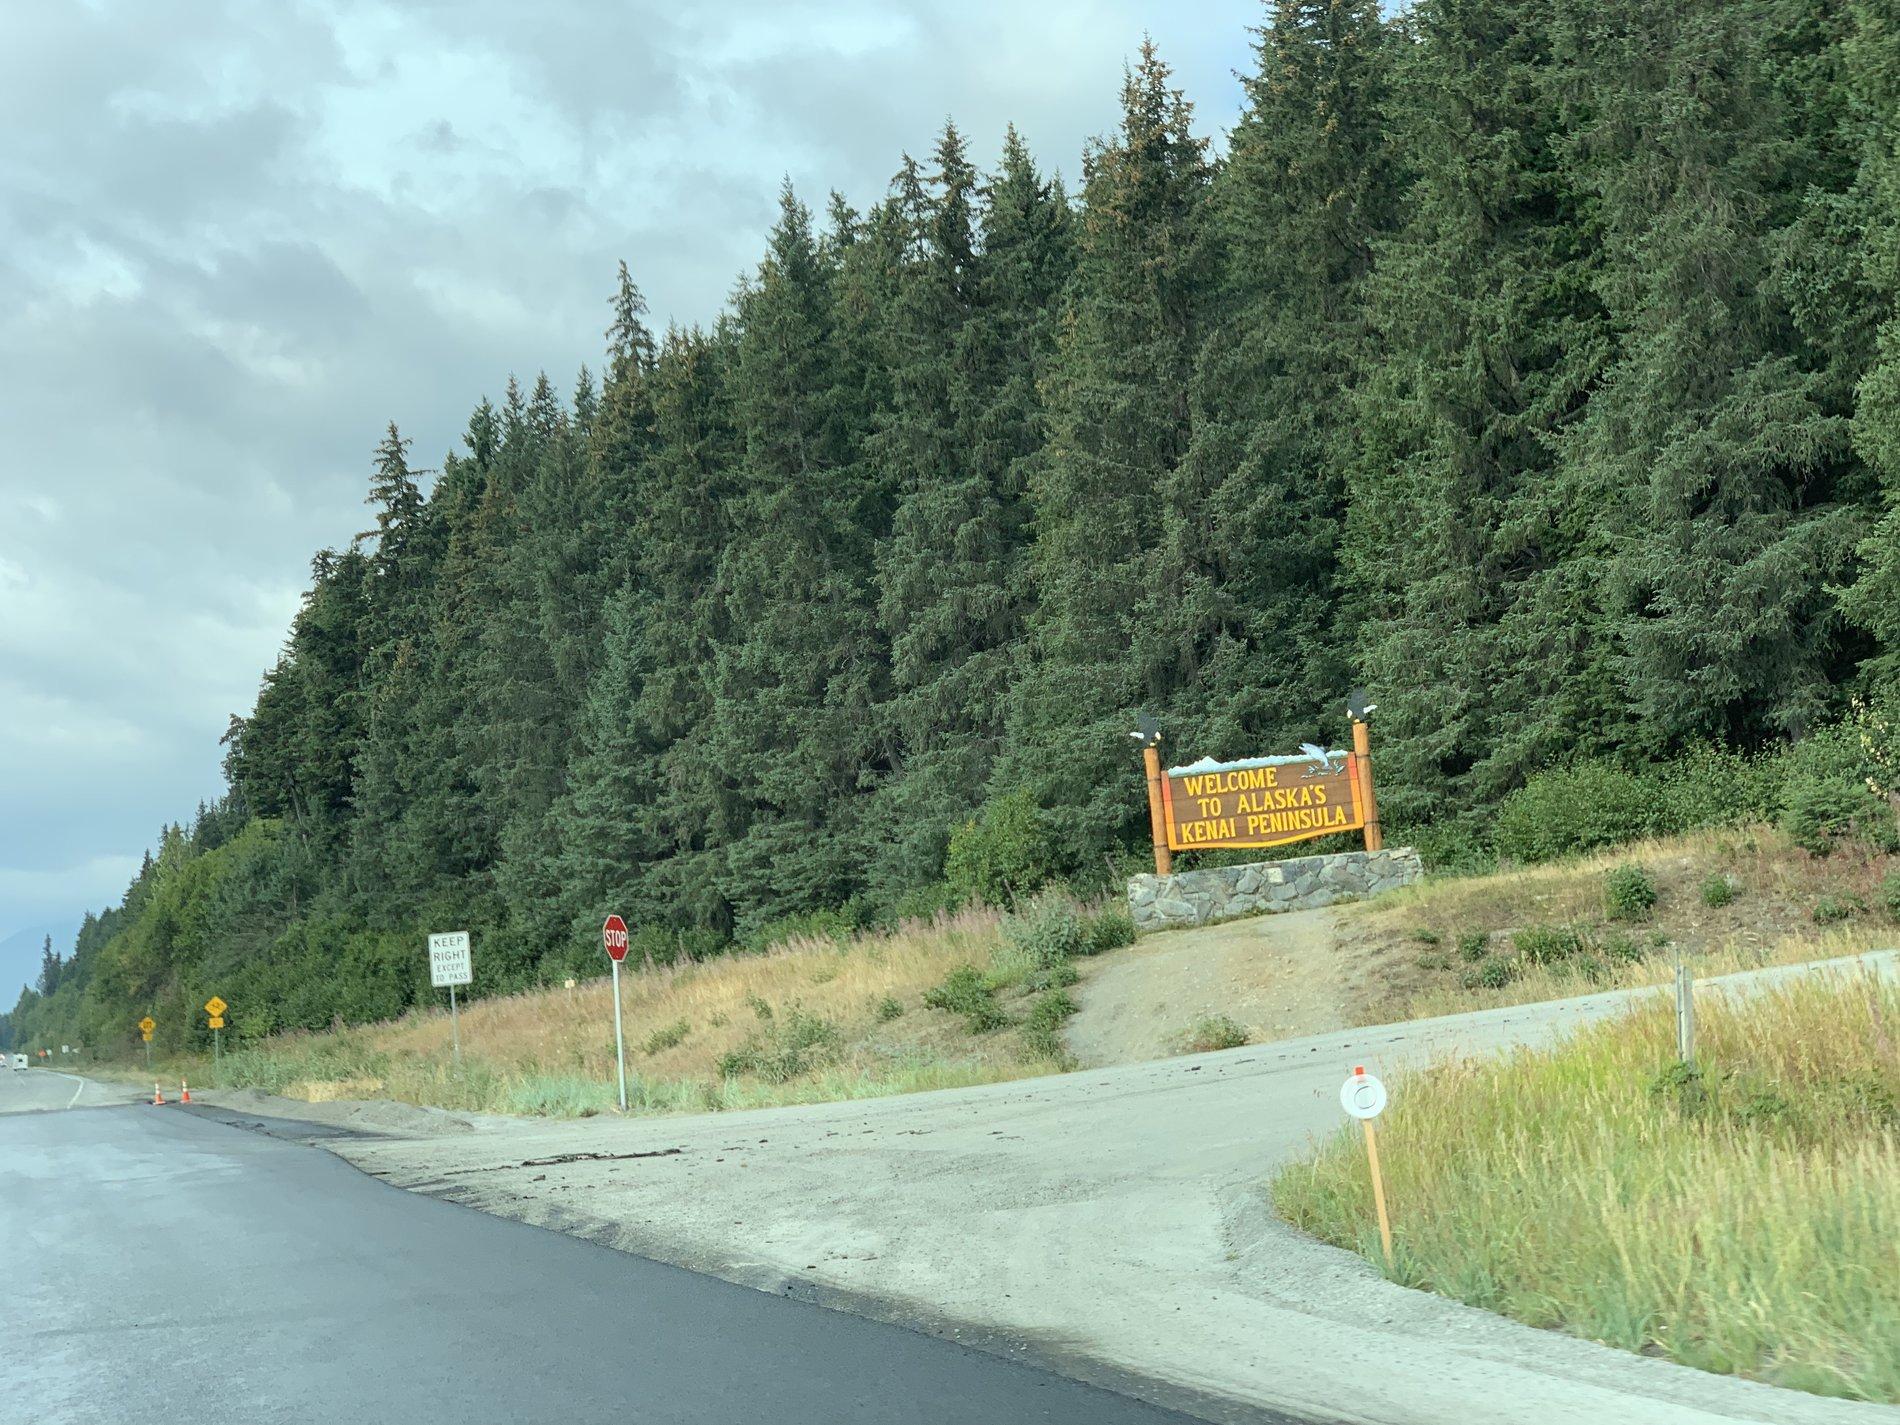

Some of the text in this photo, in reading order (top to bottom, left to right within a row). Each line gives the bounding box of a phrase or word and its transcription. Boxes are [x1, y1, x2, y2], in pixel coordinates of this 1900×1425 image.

[1183, 767, 1278, 796] WELCOME
[1197, 784, 1327, 817] TO ALASKA'S
[1181, 805, 1347, 843] KENAI PENINSULA
[433, 936, 464, 948] KEEP
[605, 929, 627, 948] STOP
[433, 950, 466, 961] RIGHT
[449, 972, 468, 981] PASS
